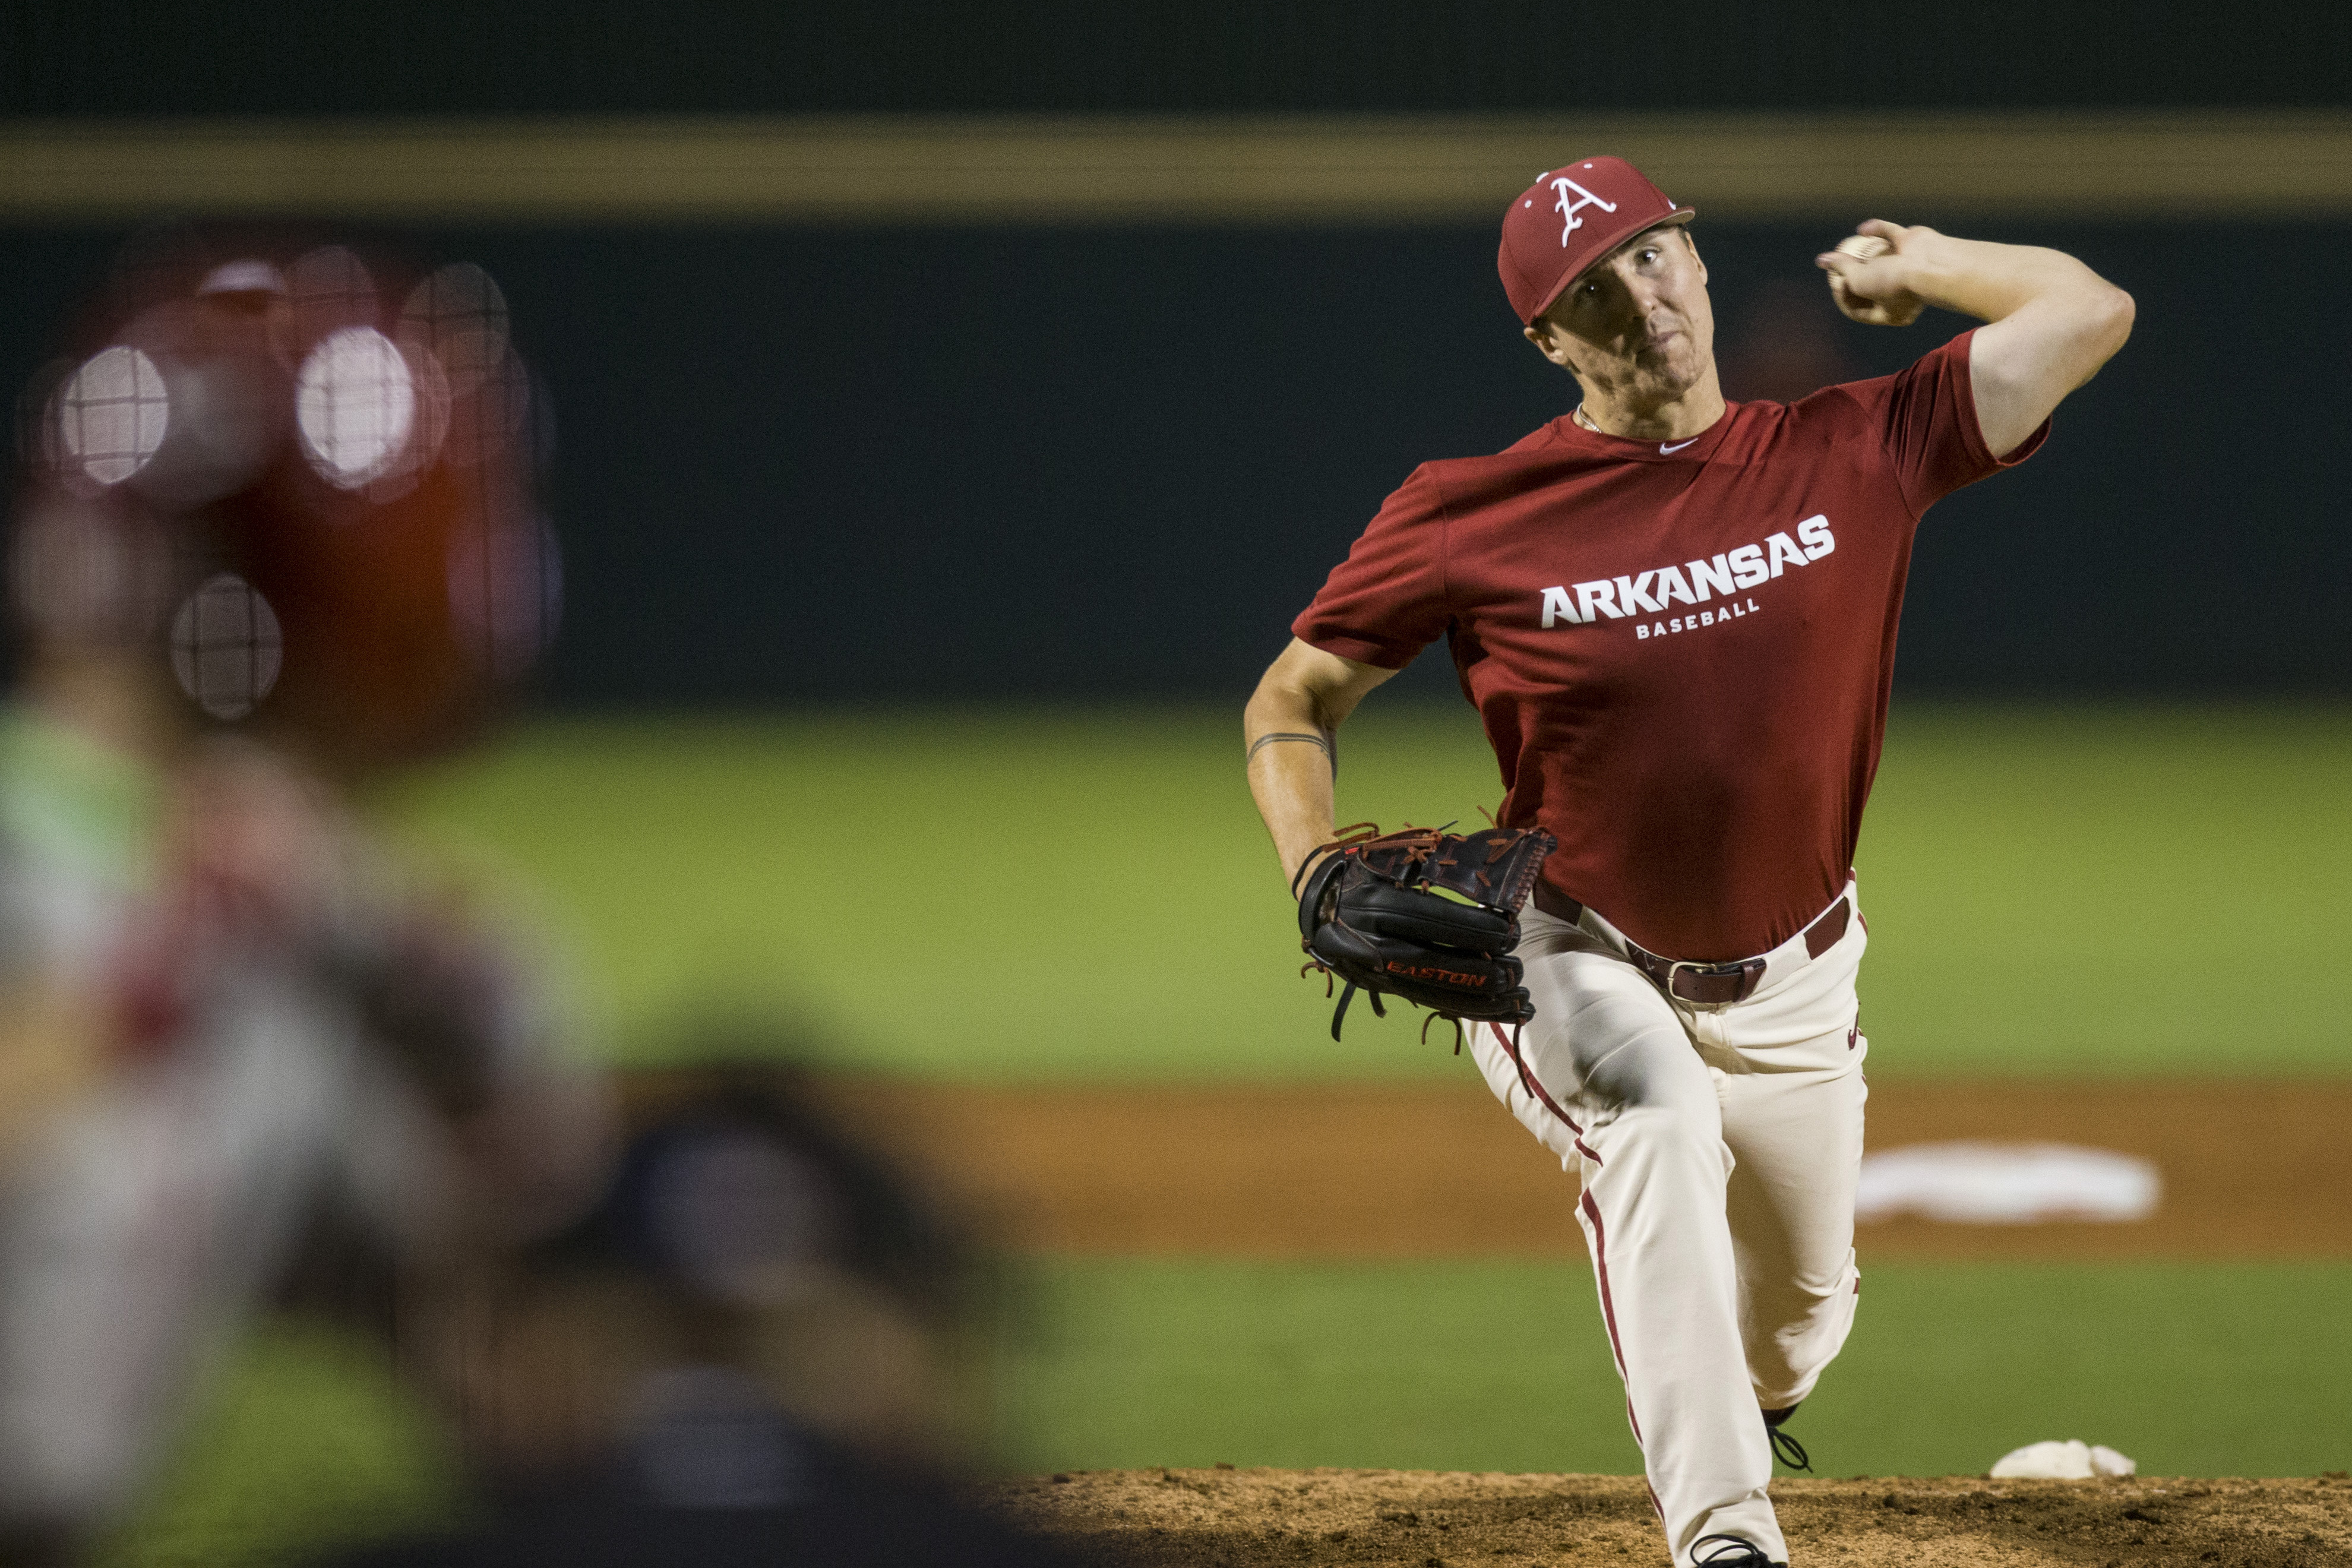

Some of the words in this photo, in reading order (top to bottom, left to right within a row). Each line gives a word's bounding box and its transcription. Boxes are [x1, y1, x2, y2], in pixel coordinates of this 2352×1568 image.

[1550, 177, 1617, 248] A
[1540, 514, 1836, 629] ARKANSAS
[1636, 598, 1760, 640] BASEBALL
[1387, 960, 1487, 987] EASTON
